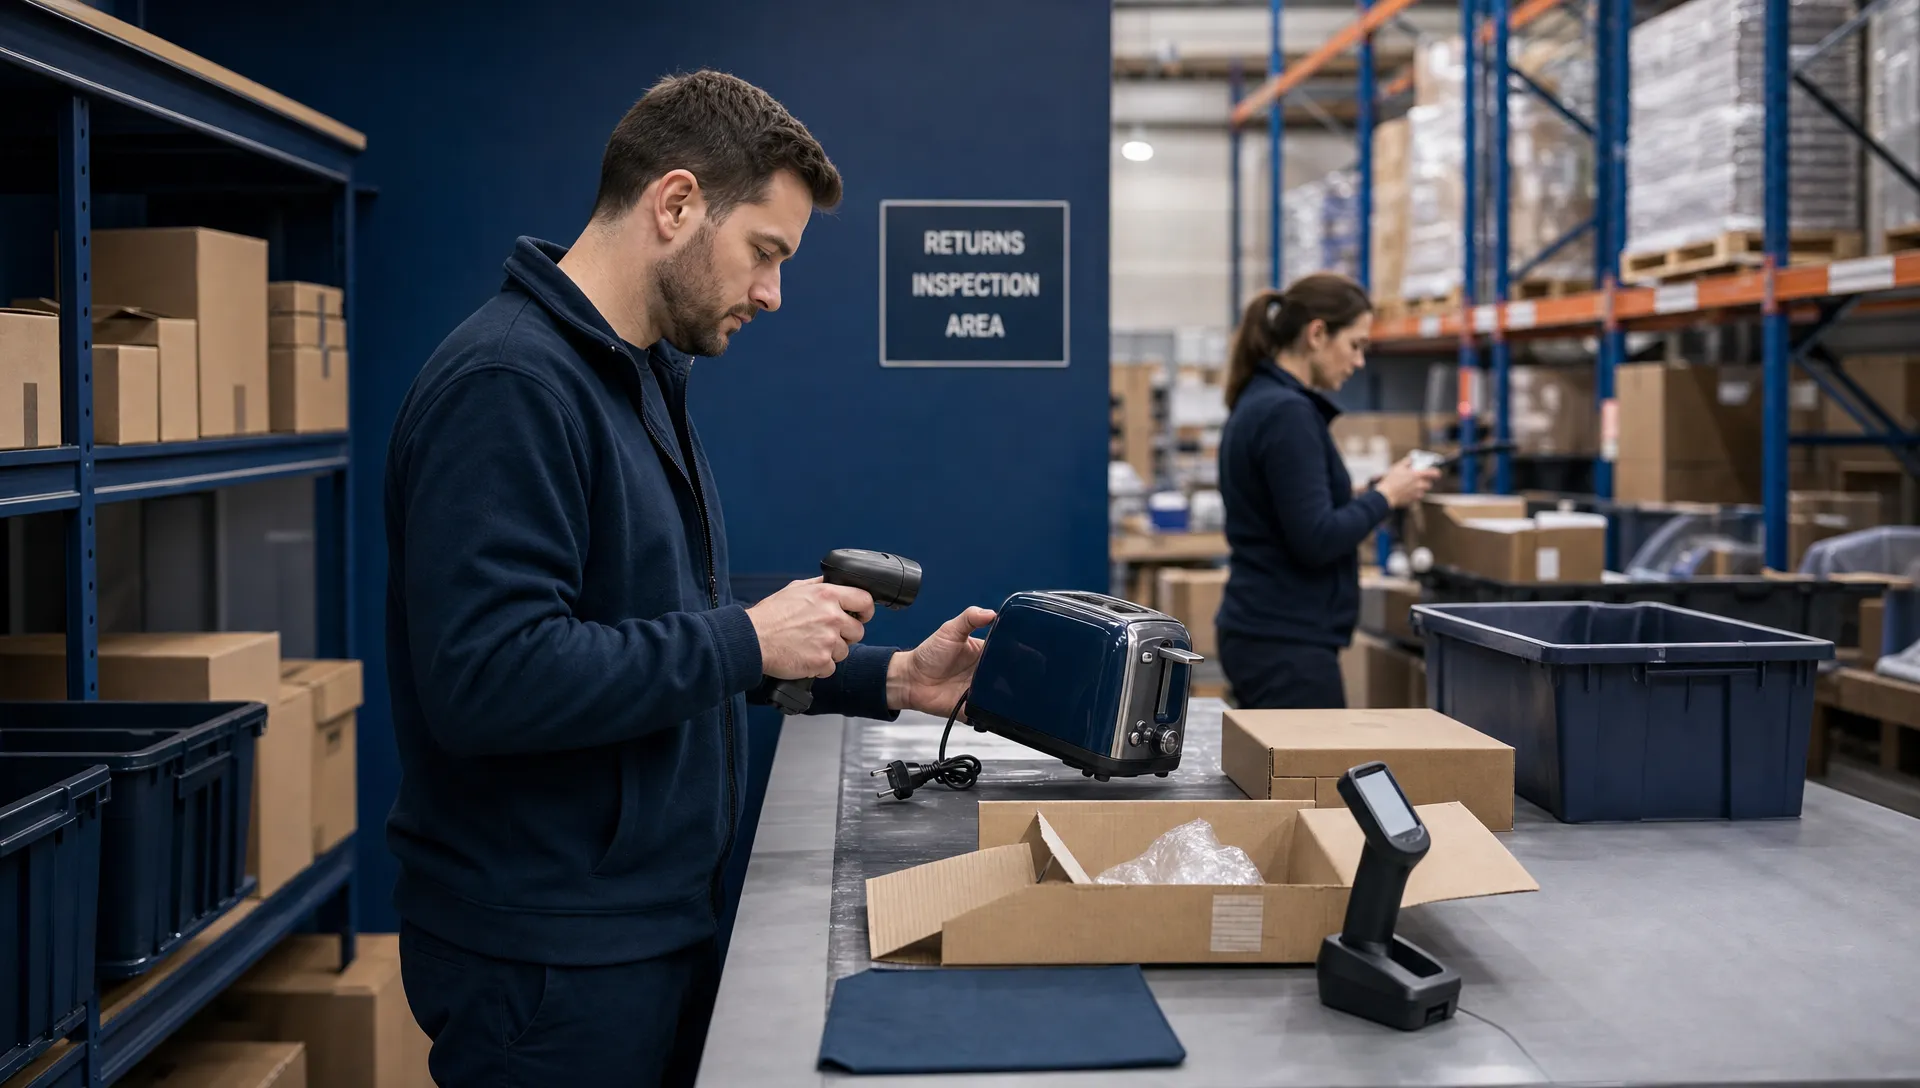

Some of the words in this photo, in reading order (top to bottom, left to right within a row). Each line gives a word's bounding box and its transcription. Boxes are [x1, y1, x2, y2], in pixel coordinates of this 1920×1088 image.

[924, 230, 1025, 255] RETURNS
[912, 273, 1040, 297] INSPECTION
[945, 313, 1005, 338] AREA
